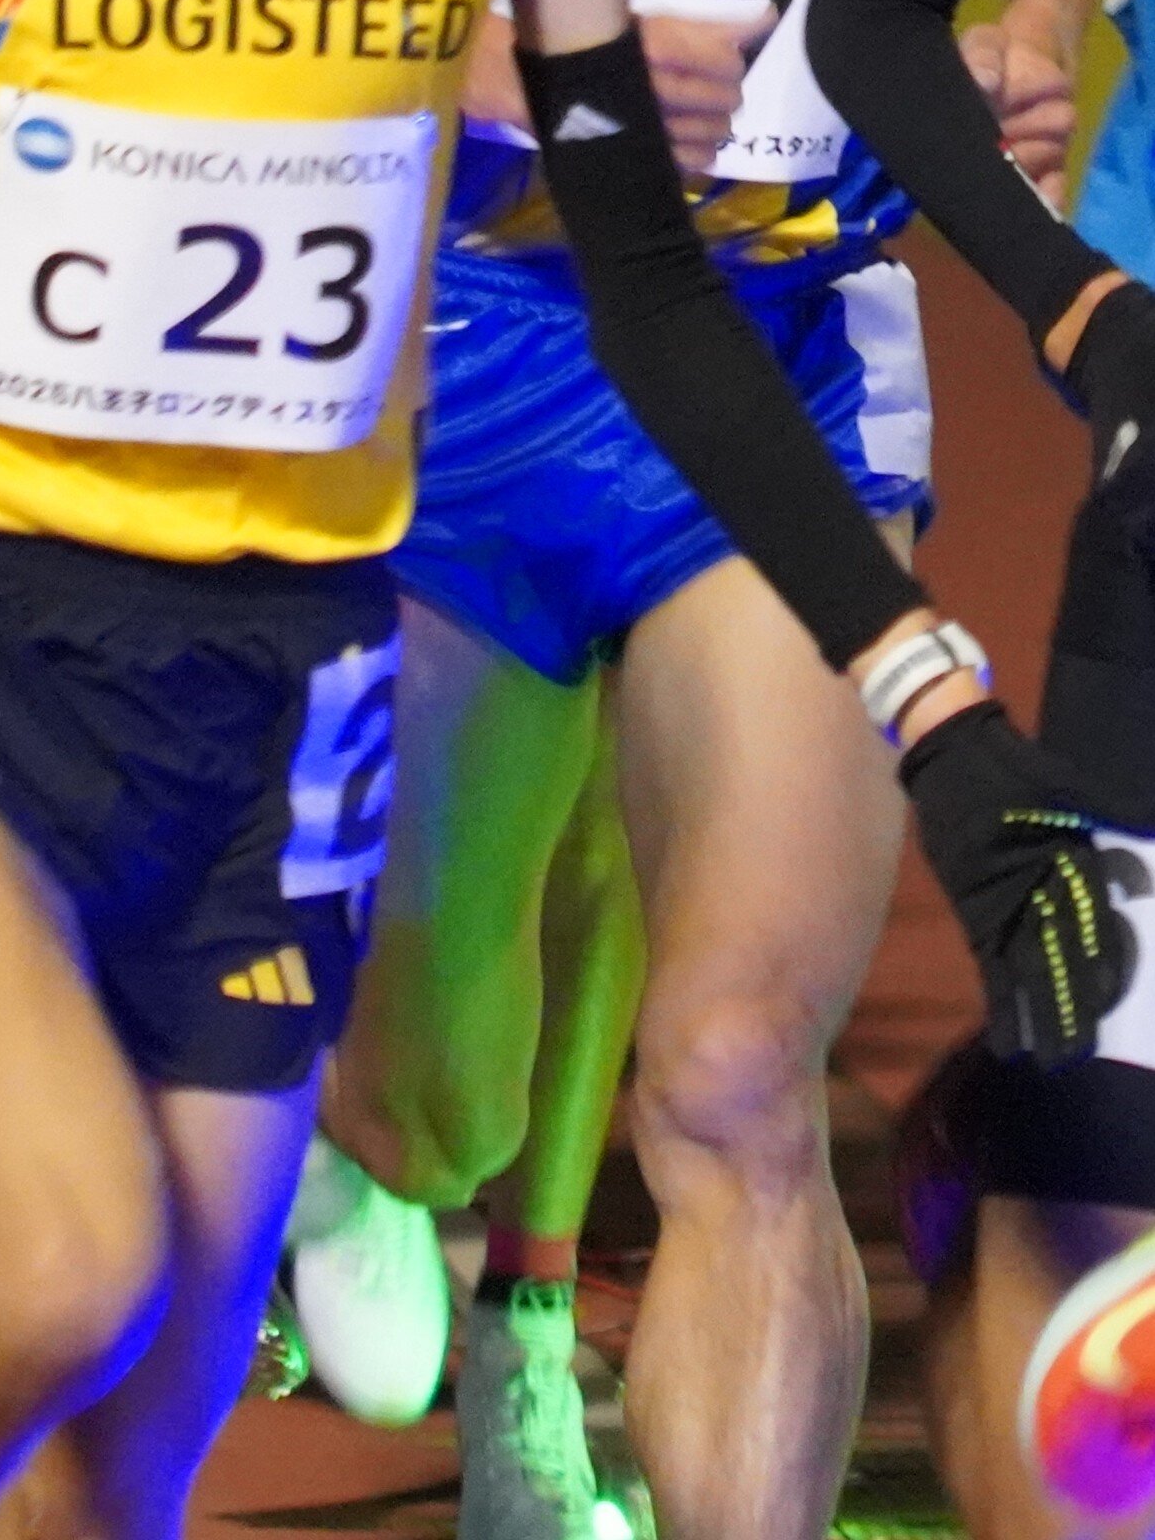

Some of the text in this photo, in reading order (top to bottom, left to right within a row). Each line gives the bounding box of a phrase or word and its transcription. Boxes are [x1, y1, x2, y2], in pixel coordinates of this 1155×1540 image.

[89, 139, 414, 187] KONICA MINOLTA
[31, 222, 374, 364] C 23
